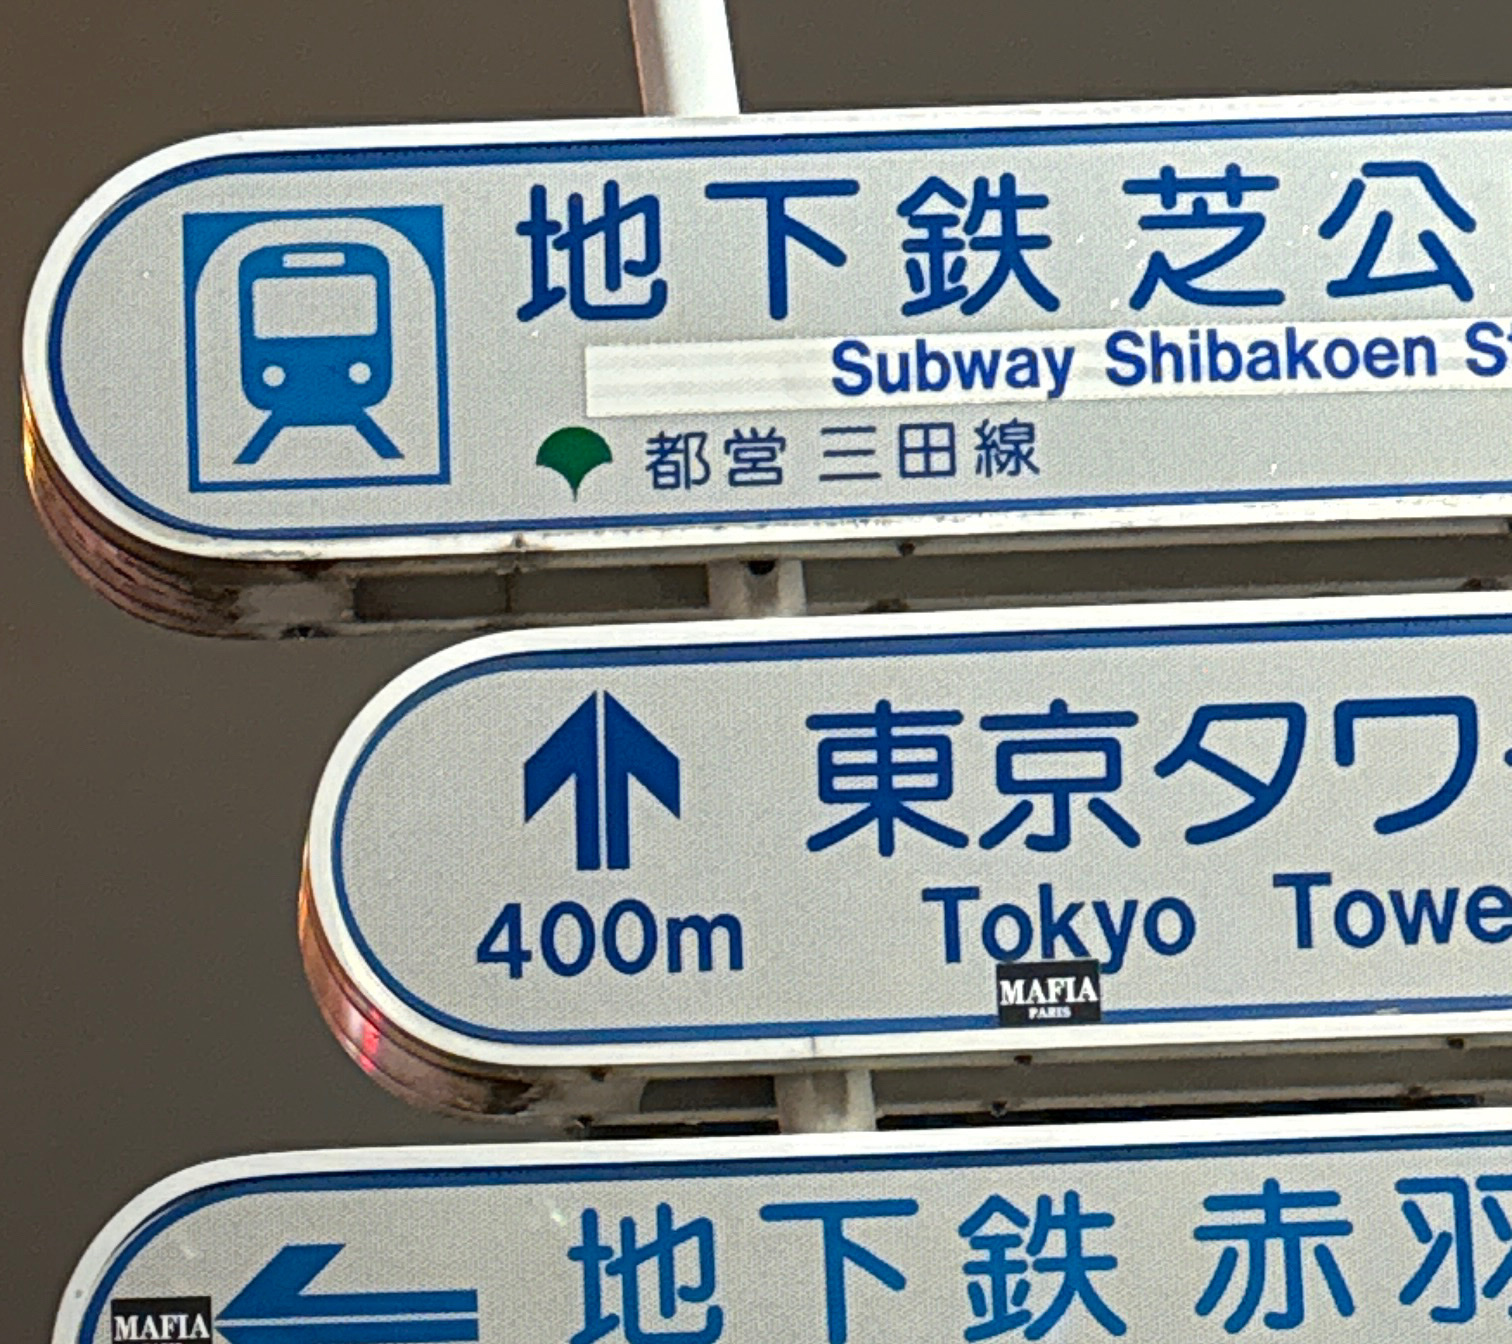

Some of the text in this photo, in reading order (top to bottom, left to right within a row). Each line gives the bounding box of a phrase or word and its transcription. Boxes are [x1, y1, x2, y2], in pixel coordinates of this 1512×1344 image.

[831, 320, 1512, 399] Subway Shibakoen S
[805, 695, 1512, 857] 東京タワ
[475, 897, 745, 979] 400m
[921, 870, 1512, 975] Tokyo Towe
[999, 976, 1098, 1006] MAFIA
[1028, 1006, 1072, 1020] PARIS
[113, 1313, 210, 1341] MAFIA
